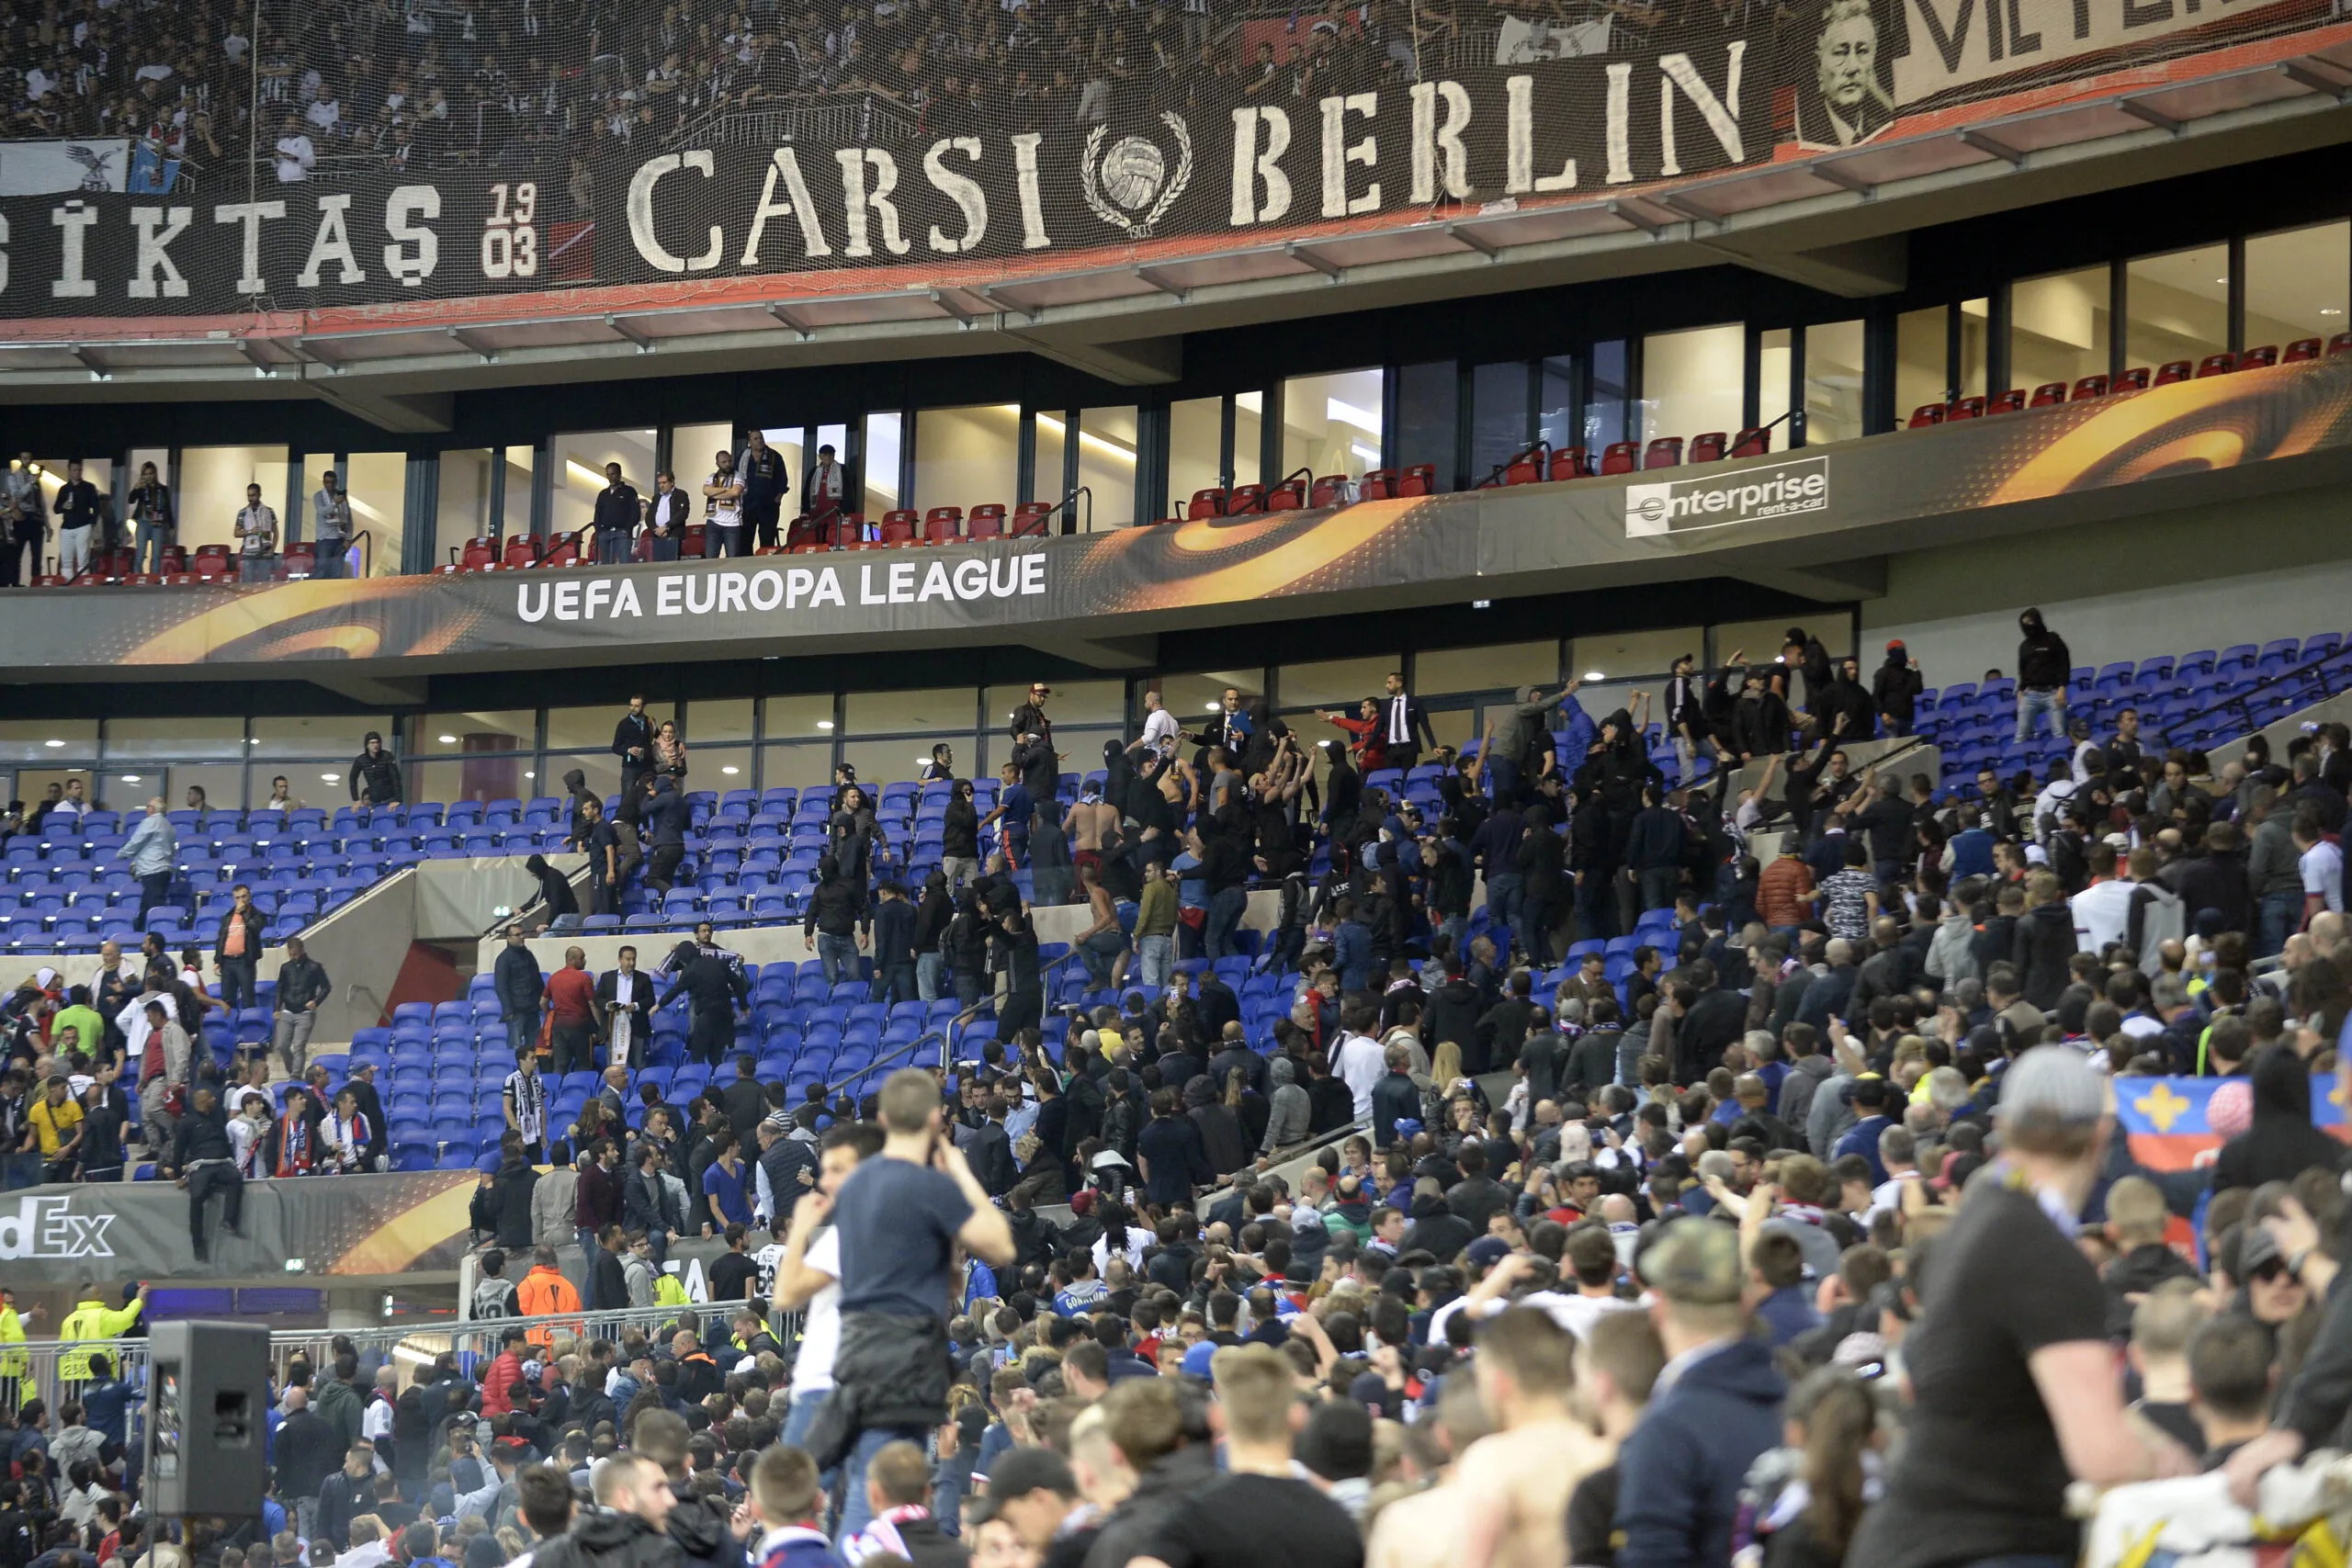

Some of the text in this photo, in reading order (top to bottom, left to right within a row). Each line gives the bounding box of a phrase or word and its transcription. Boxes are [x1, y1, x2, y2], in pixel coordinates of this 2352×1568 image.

[1229, 40, 1747, 226] BERLIN
[487, 183, 537, 226] 19
[482, 226, 538, 278] 03
[1126, 223, 1153, 239] 1903
[1638, 472, 1826, 522] enterprise
[1757, 496, 1824, 516] rent-a-car
[517, 553, 1046, 623] UEFA EUROPA LEAGUE
